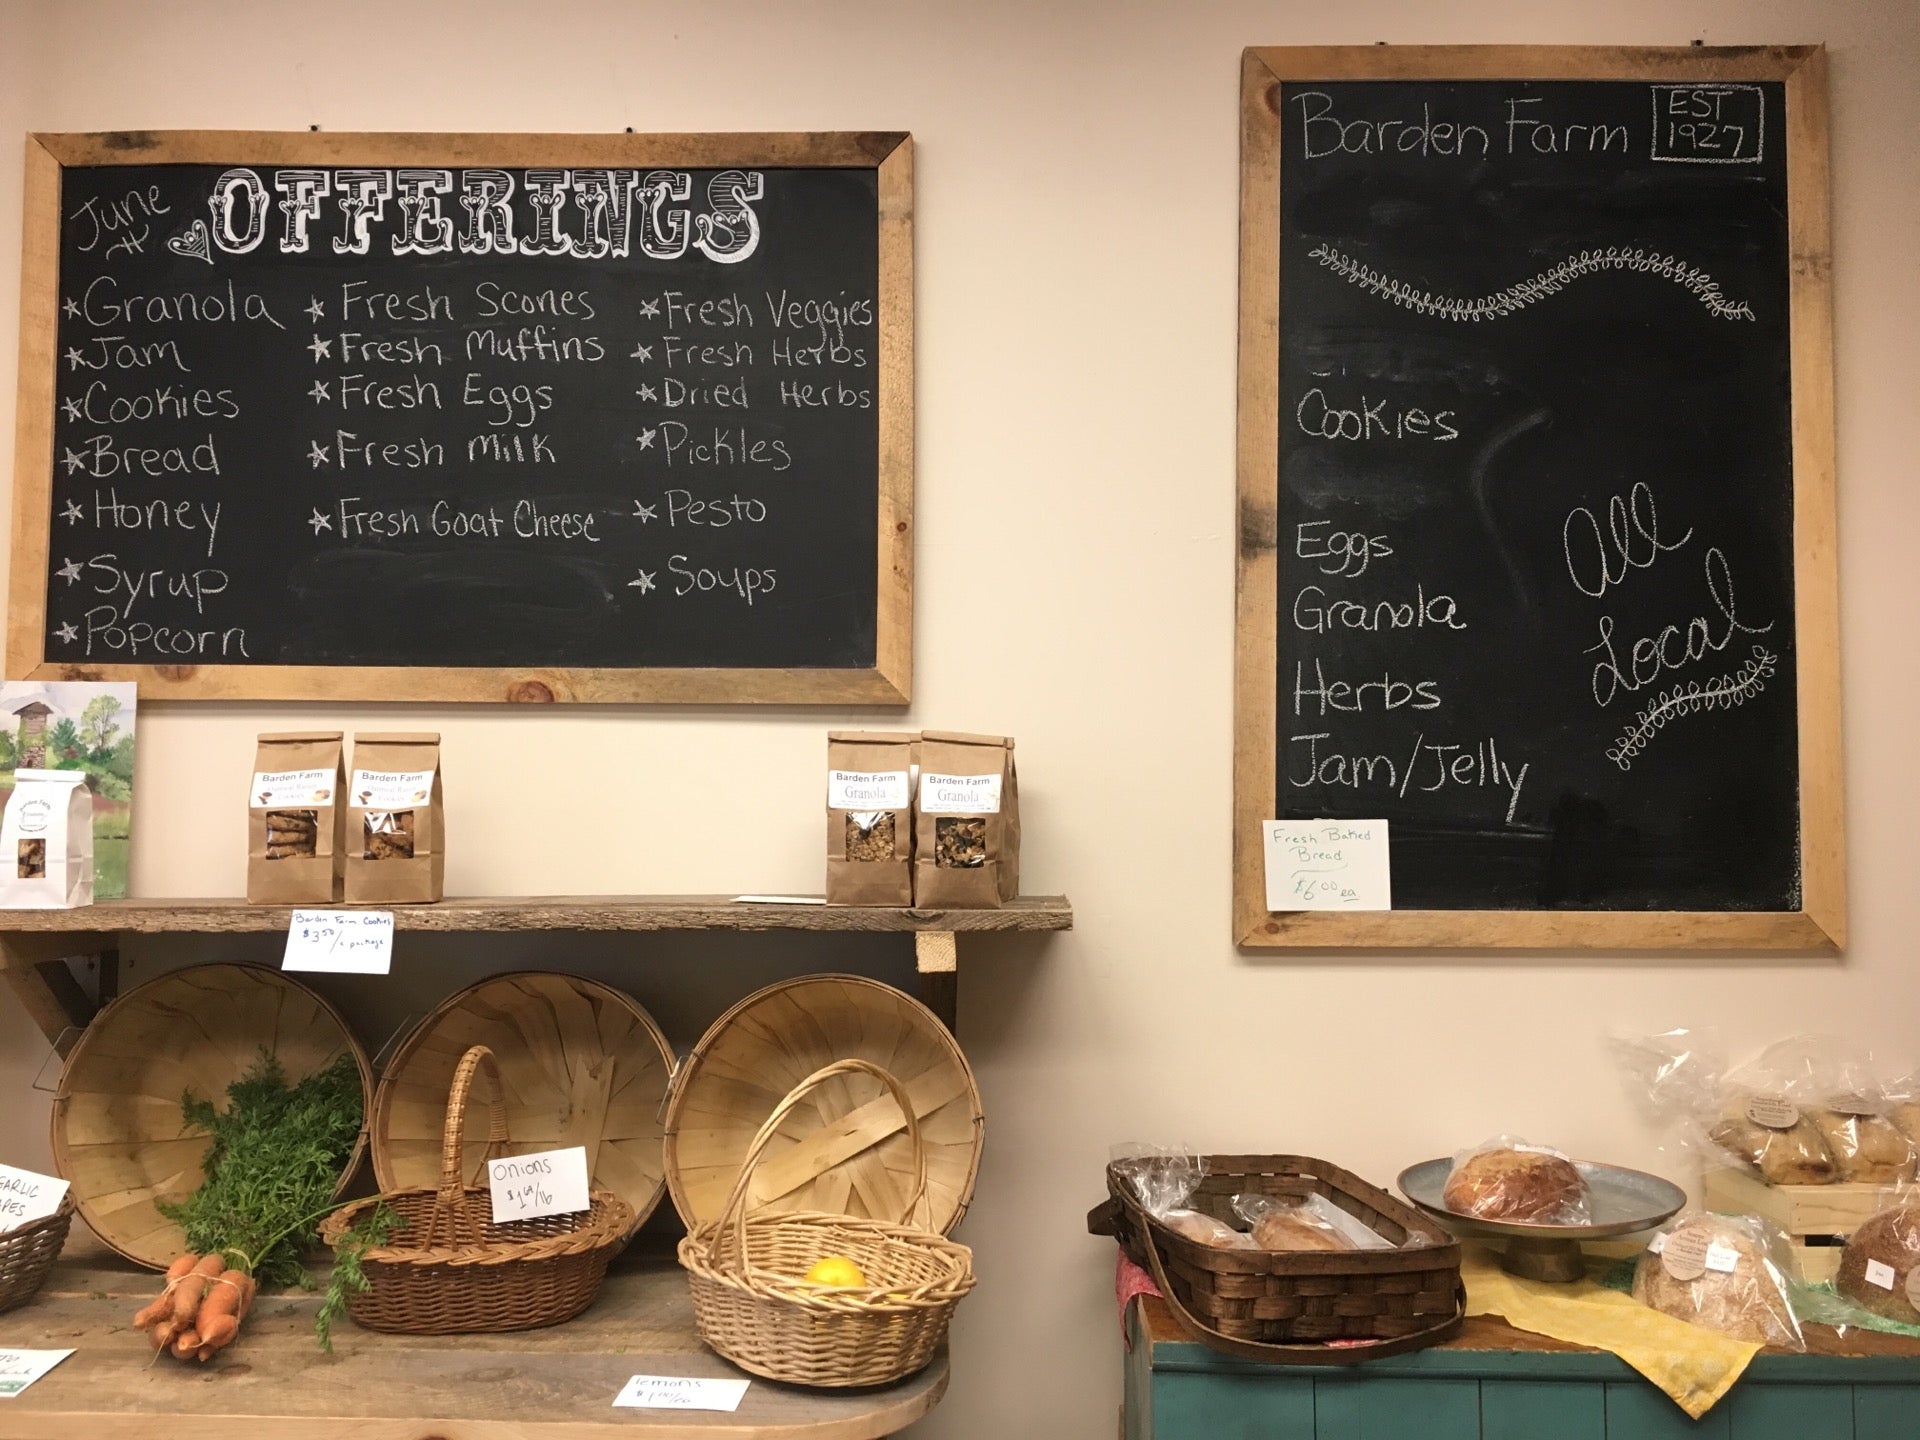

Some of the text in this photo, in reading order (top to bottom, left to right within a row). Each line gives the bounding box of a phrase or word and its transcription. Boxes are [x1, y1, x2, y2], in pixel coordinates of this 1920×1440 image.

[1292, 92, 1629, 159] Barden Farm
[1669, 90, 1734, 120] EST
[1669, 122, 1745, 158] 1927
[70, 185, 171, 251] June
[208, 168, 764, 264] OFFERINGS
[84, 276, 286, 329] Granola
[342, 281, 595, 321] Fresh Scones
[663, 290, 873, 350] Fresh Veggies
[86, 335, 191, 371] Jam
[340, 325, 605, 365] Fresh Muffins
[663, 335, 867, 368] Fresh Herbs
[85, 381, 239, 425] Cookies
[340, 373, 552, 427] Fresh Eggs
[664, 376, 870, 410] Dried Herbs
[1297, 389, 1459, 441] Cookies
[85, 434, 220, 477] Bread
[336, 429, 556, 470] Fresh Milk
[659, 421, 791, 471] Pickles
[96, 487, 220, 557] Honey
[340, 497, 600, 541] Fresh Goat Cheese
[664, 489, 767, 527] Pesto
[1296, 520, 1394, 577] Eggs
[88, 554, 229, 619] Syrup
[668, 555, 777, 606] Soups
[1293, 583, 1467, 633] Granola
[1582, 547, 1775, 706] Local
[85, 606, 250, 657] Popcorn
[1294, 657, 1442, 716] Herbs
[262, 771, 323, 782] Barden Farm
[362, 772, 423, 782] Barden Farm
[836, 773, 896, 783] Barden Farm
[844, 785, 886, 800] Granola
[929, 776, 990, 786] Barden Farm
[937, 788, 979, 803] Granola
[1289, 733, 1530, 824] Jam/Jelly
[1273, 827, 1371, 844] Fresh Baked
[1289, 846, 1342, 862] Bread
[293, 913, 327, 924] Barden
[335, 916, 357, 925] Farm
[493, 1158, 552, 1181] Onions
